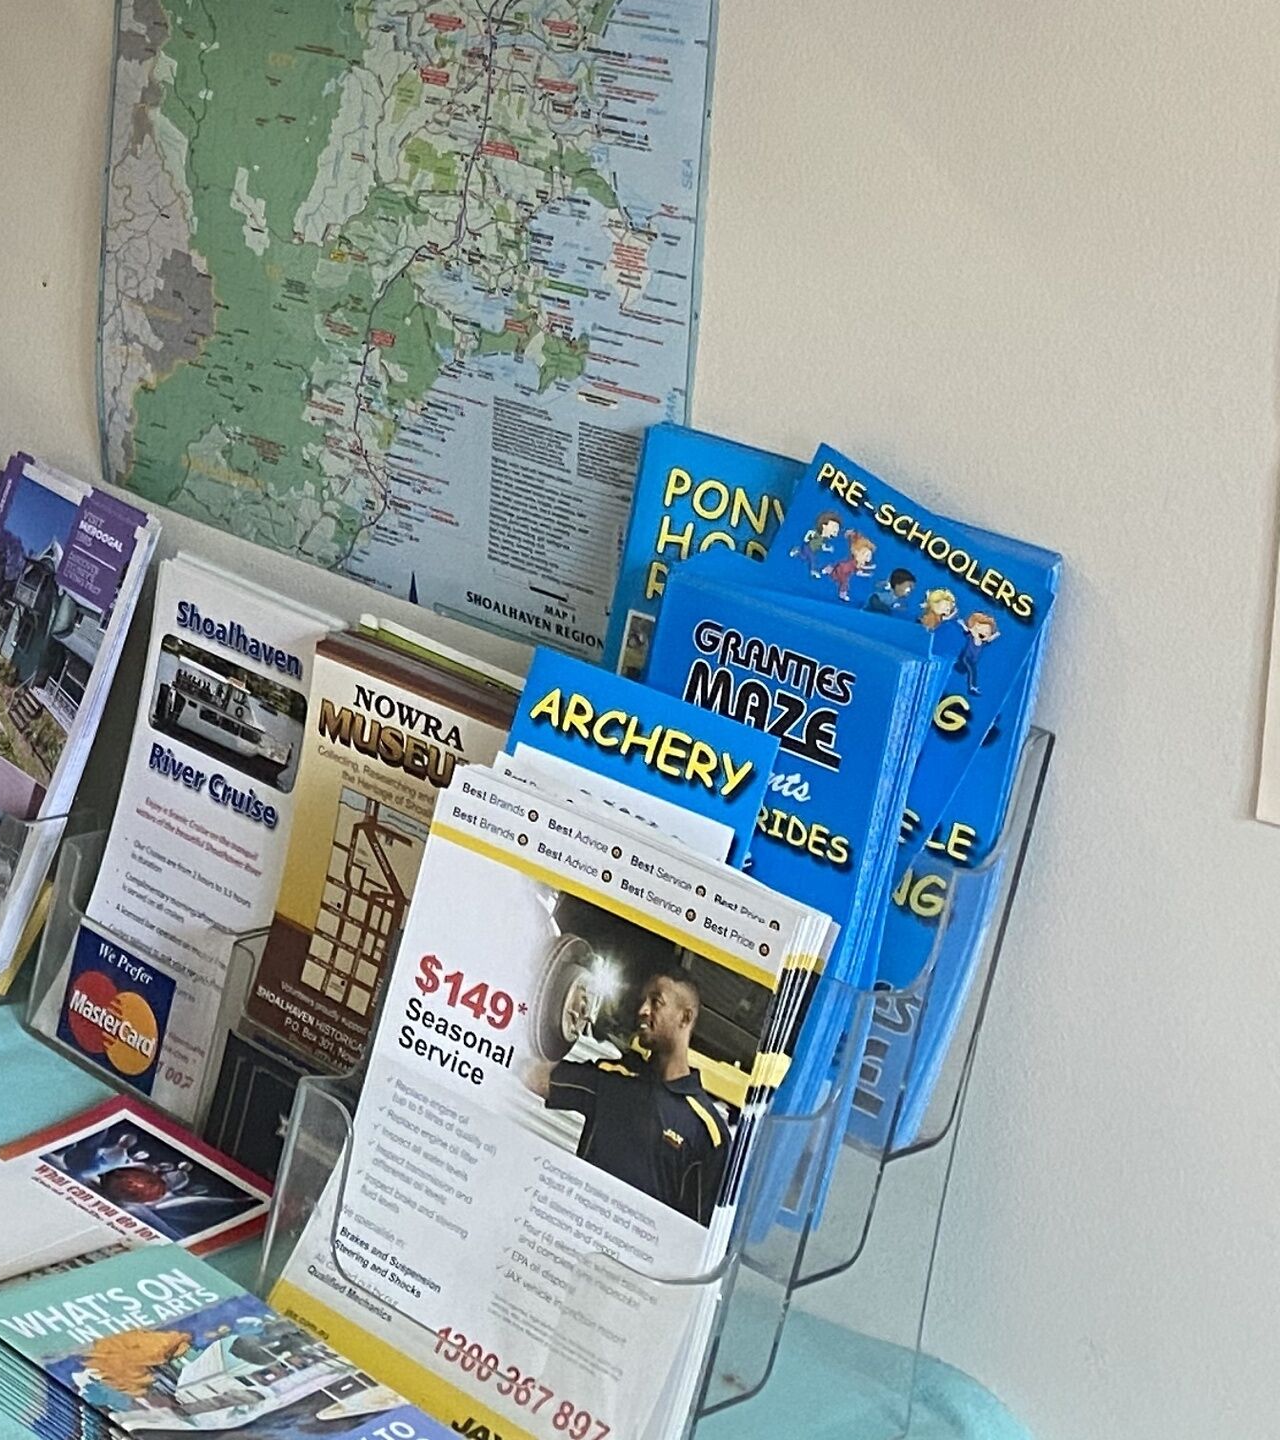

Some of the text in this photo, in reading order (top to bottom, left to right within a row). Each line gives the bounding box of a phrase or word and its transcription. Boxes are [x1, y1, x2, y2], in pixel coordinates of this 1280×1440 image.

[816, 462, 1034, 620] PRE-SCHOOLERS
[176, 599, 304, 680] Shoalhaven
[466, 591, 604, 649] SHOALHAVEN REGION
[544, 604, 568, 620] MAP
[693, 618, 857, 706] GRANTIES
[318, 698, 470, 788] MUSEU
[353, 684, 464, 752] NOWRA
[528, 686, 754, 798] ARCHERY
[148, 741, 208, 793] River
[209, 771, 279, 831] Cruise
[452, 807, 755, 950] Best Brands Best Advice Best Service Best Price
[98, 943, 153, 985] We Prefer
[69, 989, 157, 1058] MasterCard
[397, 1024, 486, 1086] Service
[404, 997, 515, 1069] Seasonal
[333, 1239, 422, 1299] Steering and Shocks
[339, 1226, 442, 1294] Brakes and Suspension
[0, 1268, 202, 1339] WHAT'S ON
[66, 1288, 219, 1345] IN THE ARTS
[434, 1327, 499, 1382] 1300
[497, 1366, 554, 1415] 367
